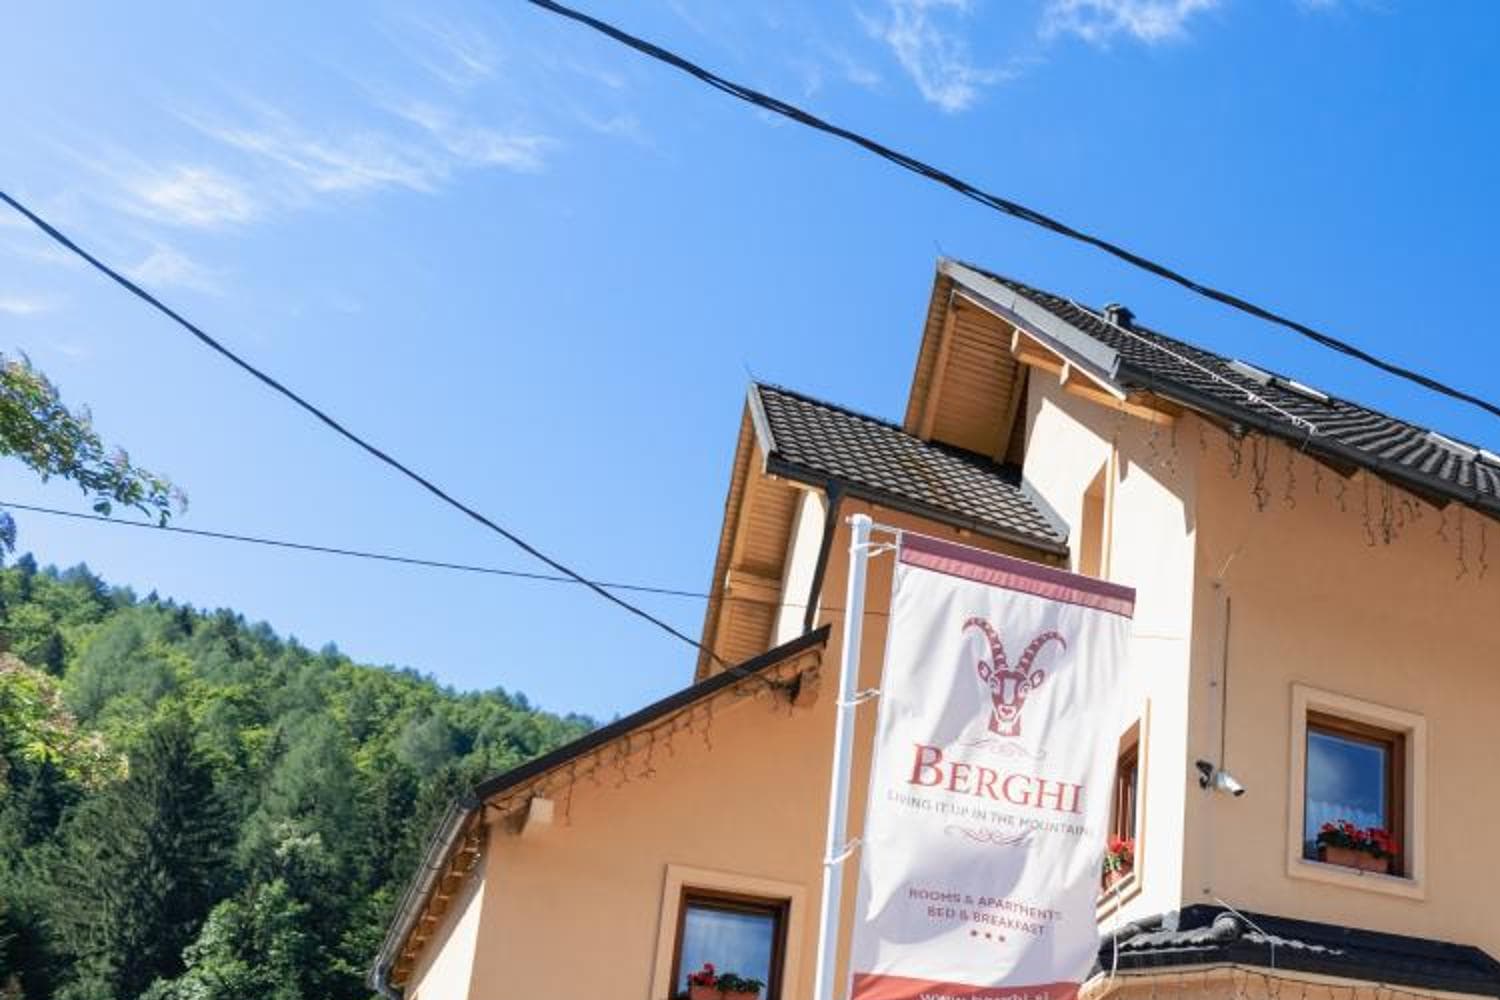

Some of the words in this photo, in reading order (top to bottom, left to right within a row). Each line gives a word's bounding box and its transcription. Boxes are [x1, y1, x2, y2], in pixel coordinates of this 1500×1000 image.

[908, 743, 1085, 815] BERGHI
[972, 806, 988, 821] IN
[990, 810, 1015, 827] THE
[1019, 814, 1092, 837] MOUNTAIN
[909, 887, 961, 903] ROOMS
[928, 905, 955, 919] BED
[973, 911, 1045, 936] BREAKFAST
